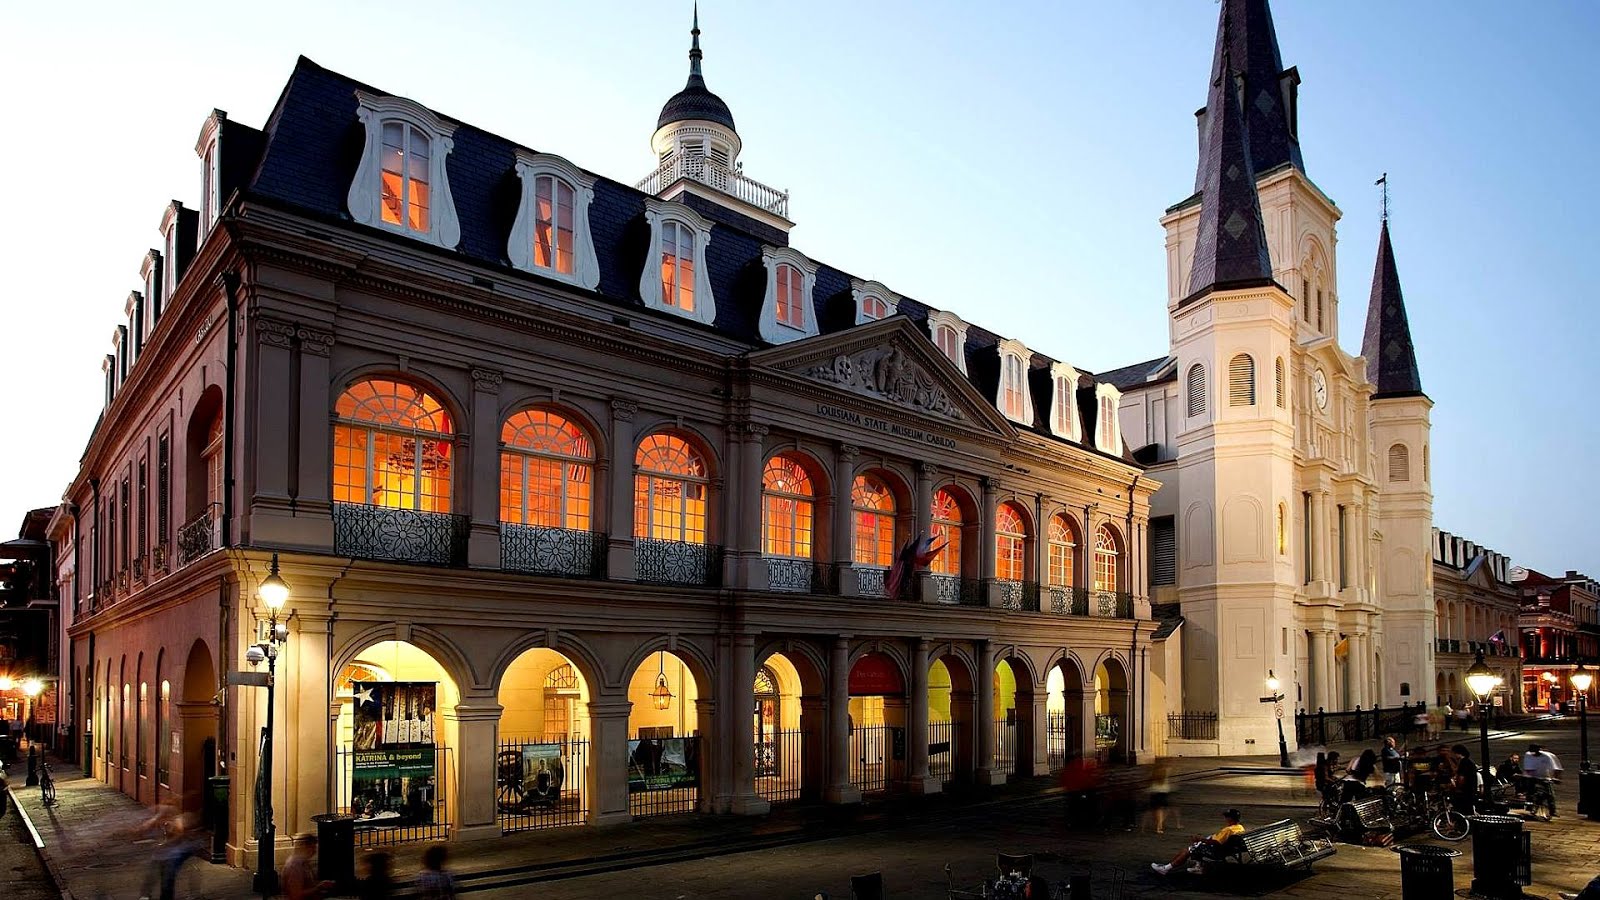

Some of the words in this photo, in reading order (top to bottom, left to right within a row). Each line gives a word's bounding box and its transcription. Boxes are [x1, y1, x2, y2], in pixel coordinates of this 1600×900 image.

[816, 404, 861, 424] LOUISIANA
[864, 418, 888, 431] STATE
[891, 426, 923, 442] MUSEUM
[926, 434, 956, 448] CABILDO
[396, 752, 422, 762] beyond
